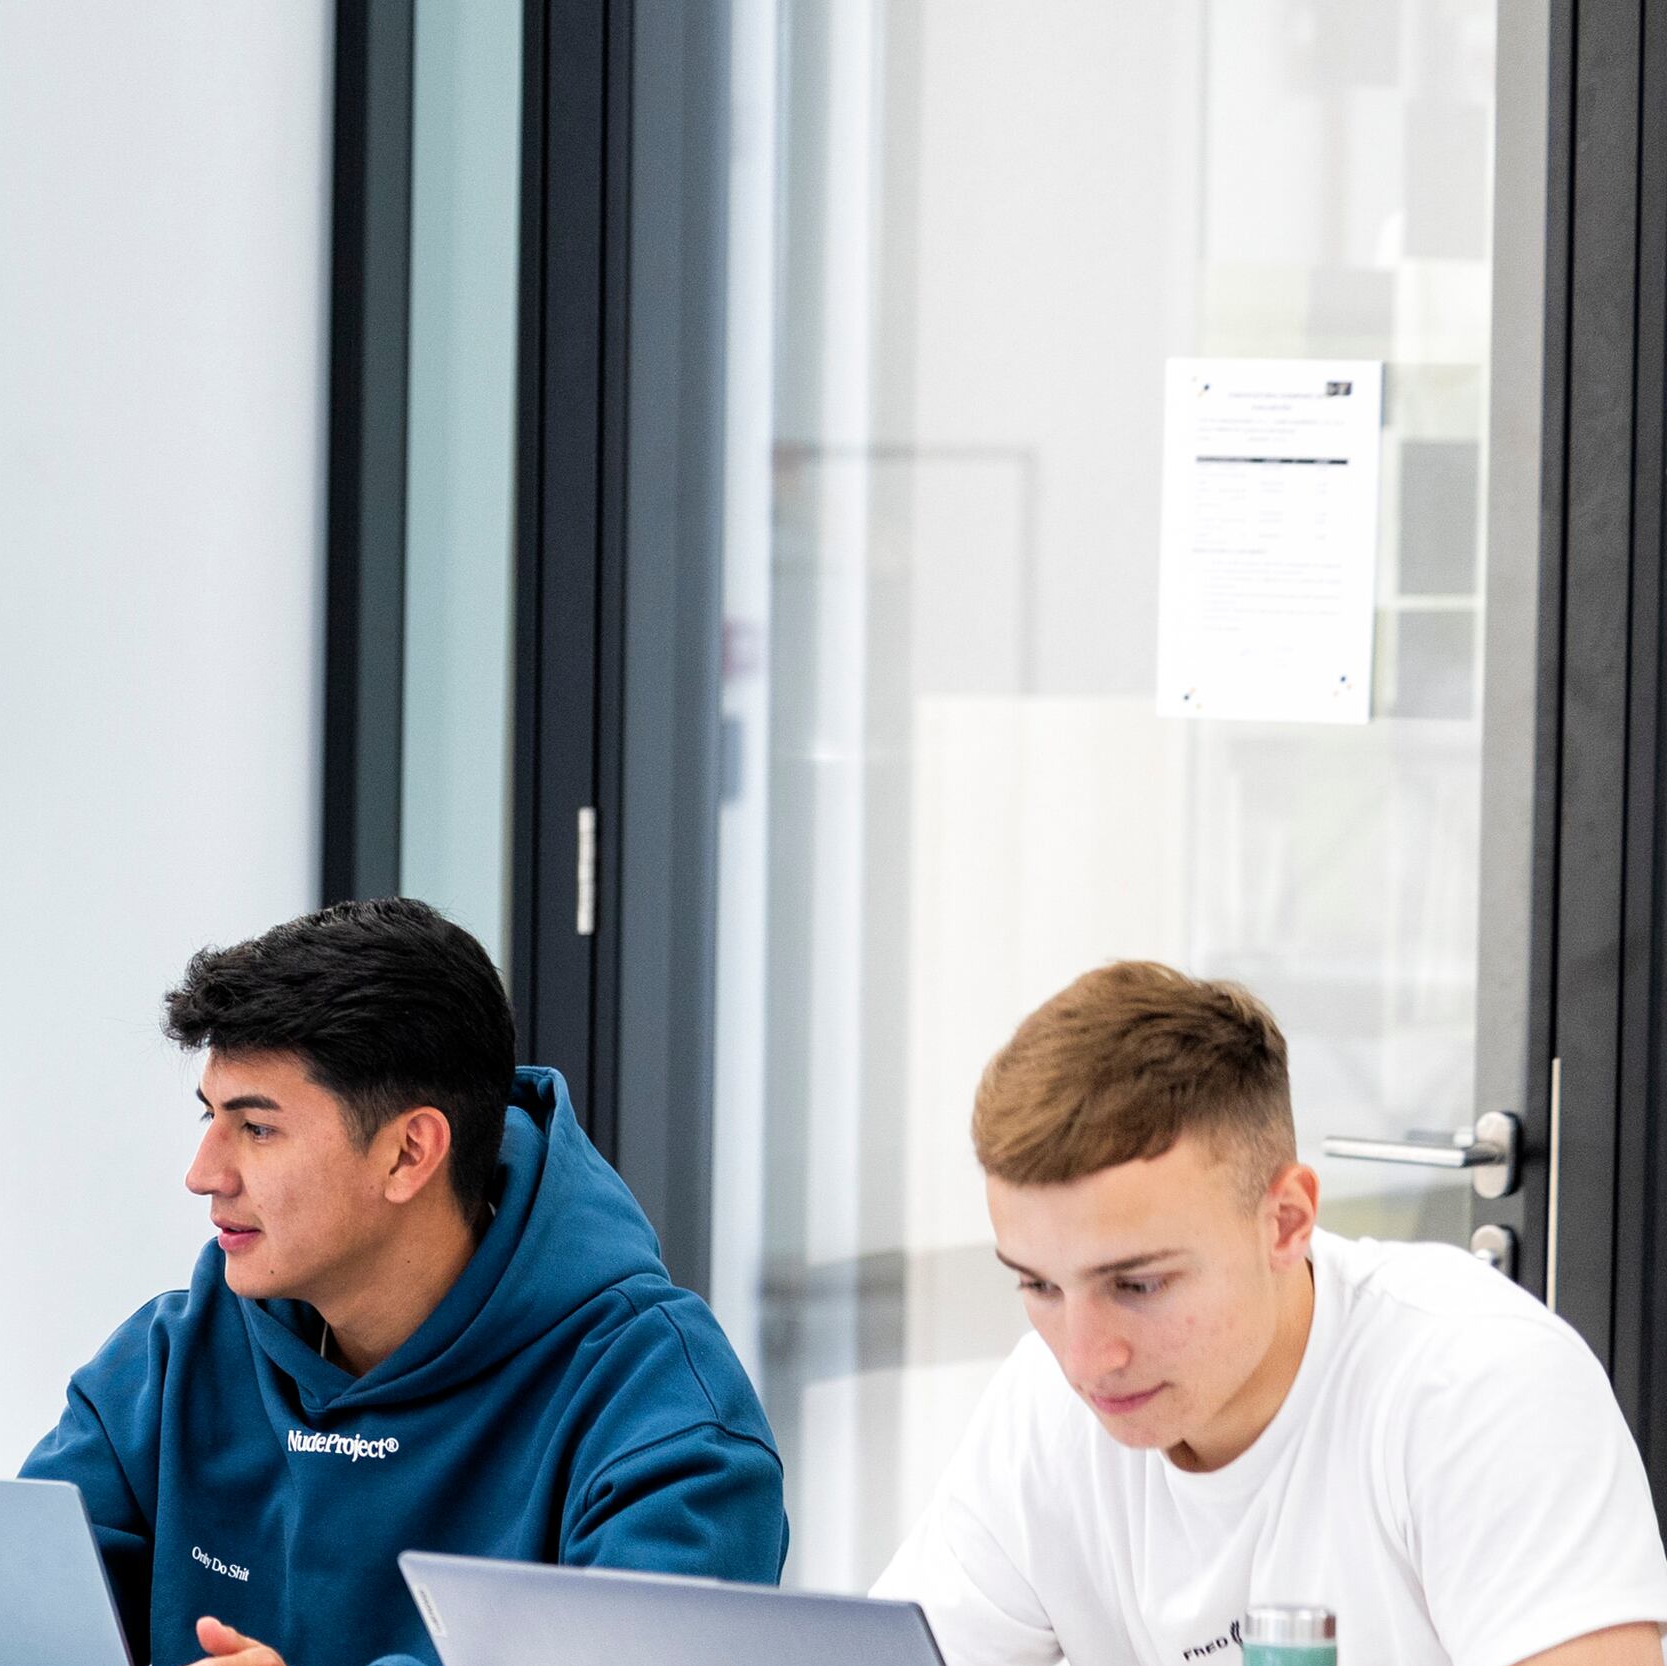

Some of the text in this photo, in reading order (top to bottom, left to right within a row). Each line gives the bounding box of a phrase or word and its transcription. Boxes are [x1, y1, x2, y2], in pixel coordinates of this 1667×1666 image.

[192, 1546, 250, 1582] Only Do Shit
